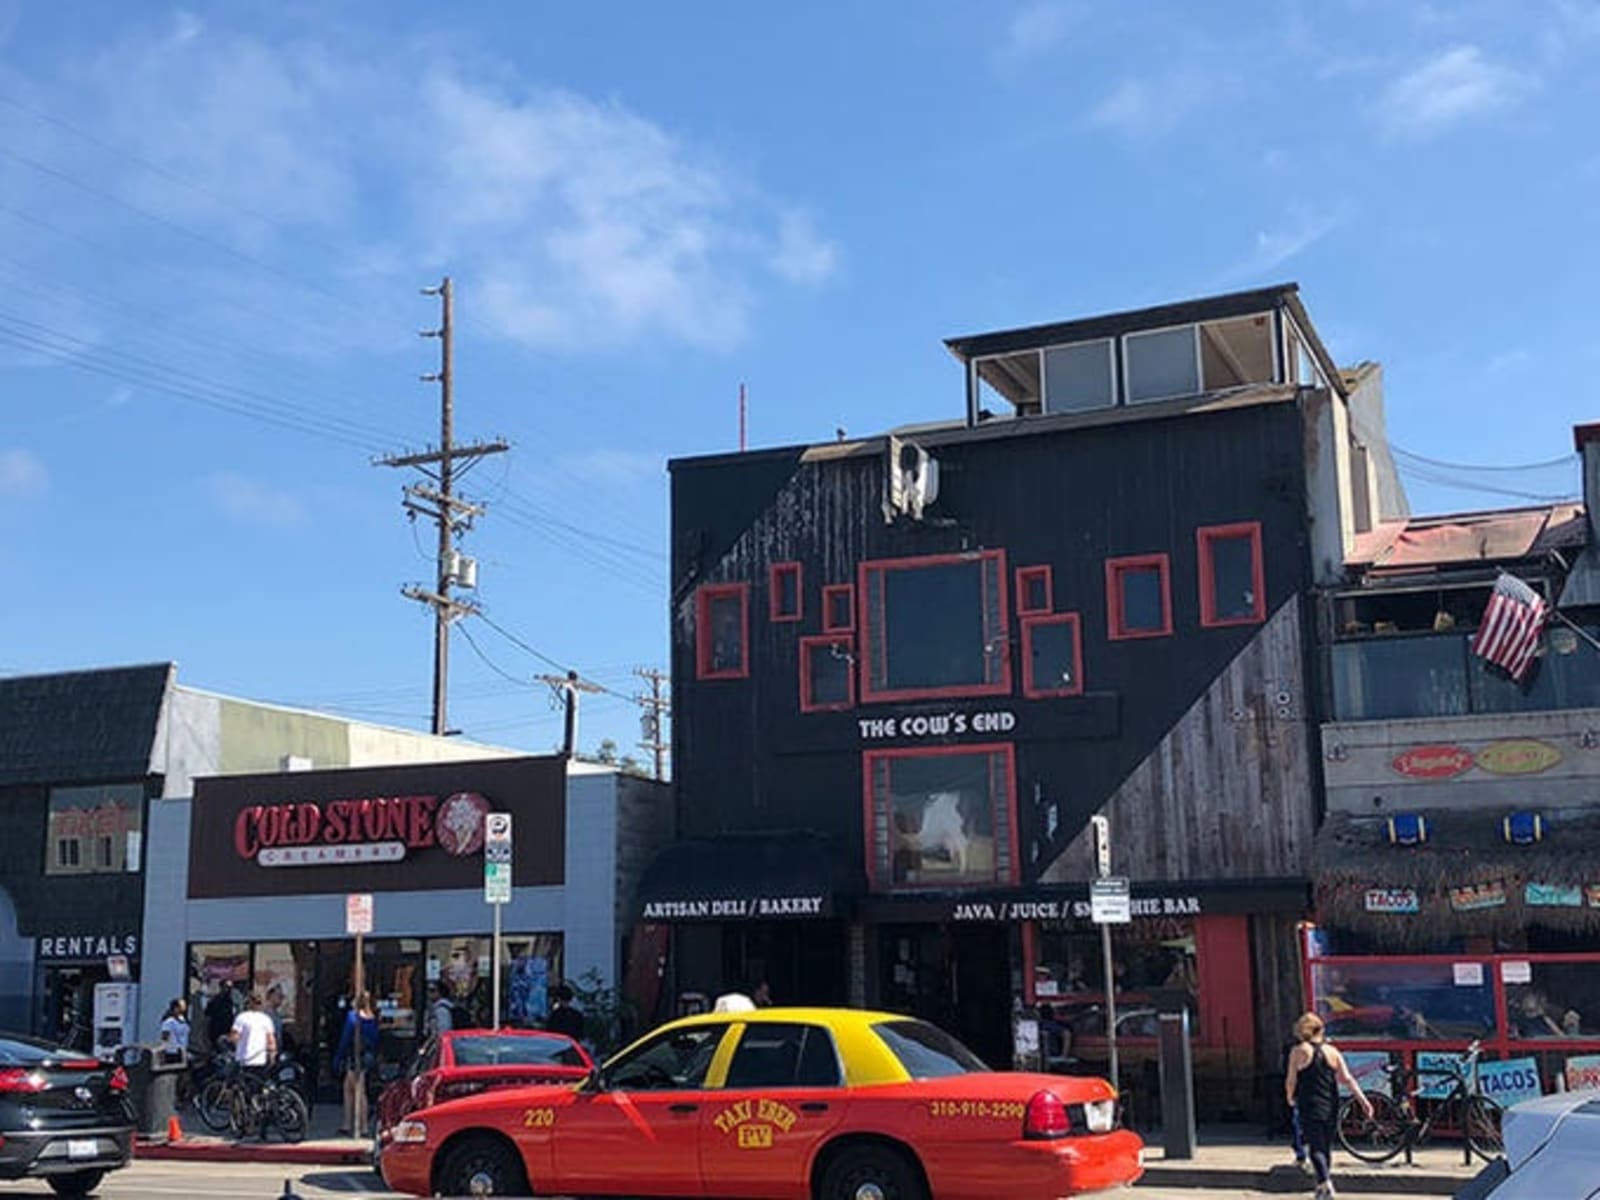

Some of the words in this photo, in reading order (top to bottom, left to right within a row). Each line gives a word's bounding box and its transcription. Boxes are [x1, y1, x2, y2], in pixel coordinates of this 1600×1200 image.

[858, 718, 896, 738] THE
[901, 712, 967, 736] COW'S
[972, 711, 1015, 732] END
[234, 803, 320, 859] COLD
[323, 796, 438, 849] STONE
[265, 846, 398, 862] CREAMERY
[643, 901, 709, 917] ARTISAN
[711, 900, 746, 916] DELI
[759, 897, 822, 914] BAKERY
[953, 904, 995, 920] JAVA
[1009, 902, 1058, 919] JUICE
[1164, 897, 1201, 914] BAR
[41, 935, 137, 956] RENTALS
[1481, 1068, 1536, 1095] TACOS
[524, 1109, 554, 1127] 220
[713, 1099, 751, 1133] TAXI
